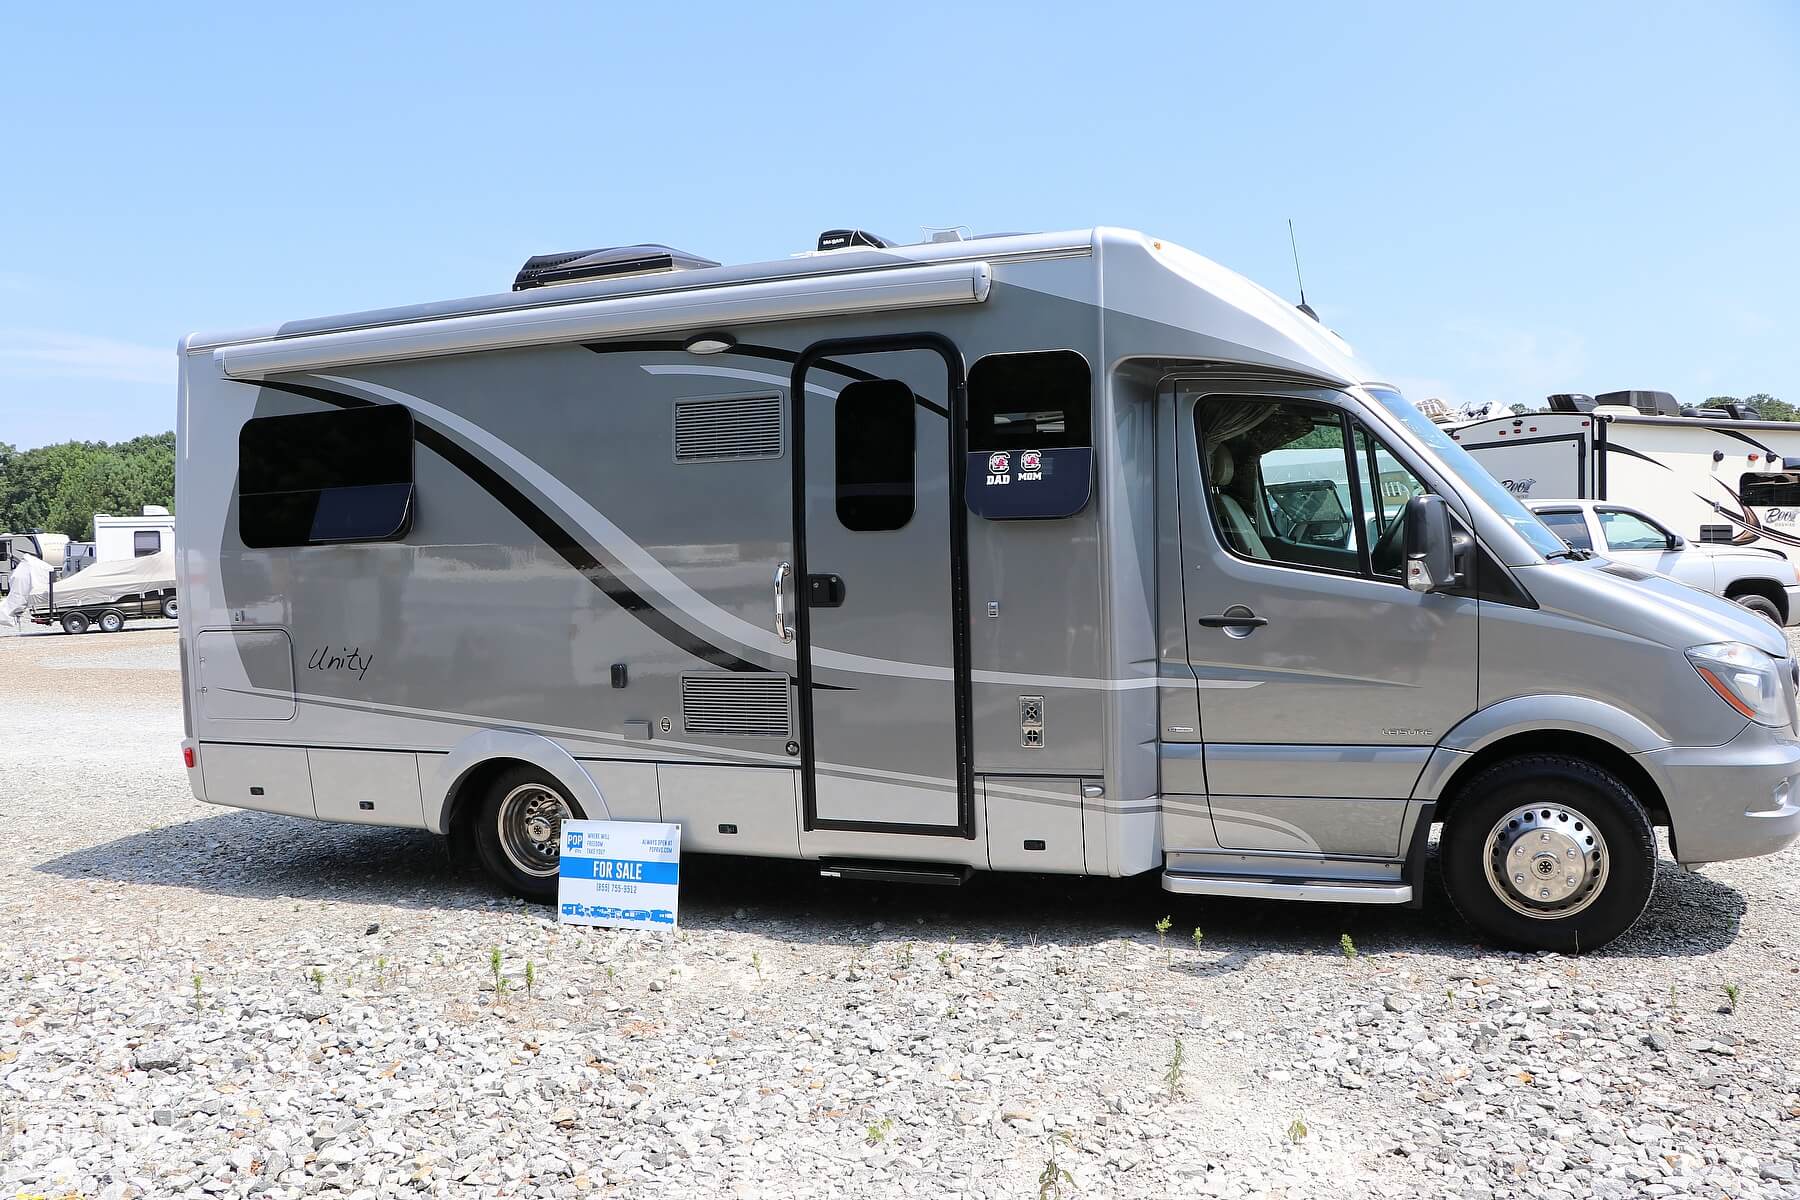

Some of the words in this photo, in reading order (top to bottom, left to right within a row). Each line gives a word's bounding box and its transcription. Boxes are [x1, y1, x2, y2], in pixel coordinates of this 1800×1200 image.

[986, 474, 1011, 485] DAD
[1018, 472, 1042, 481] MOM
[308, 645, 373, 681] Unity
[1382, 728, 1433, 736] LEISURE
[567, 834, 583, 847] POP
[593, 861, 613, 879] FOR
[615, 863, 643, 880] SALE
